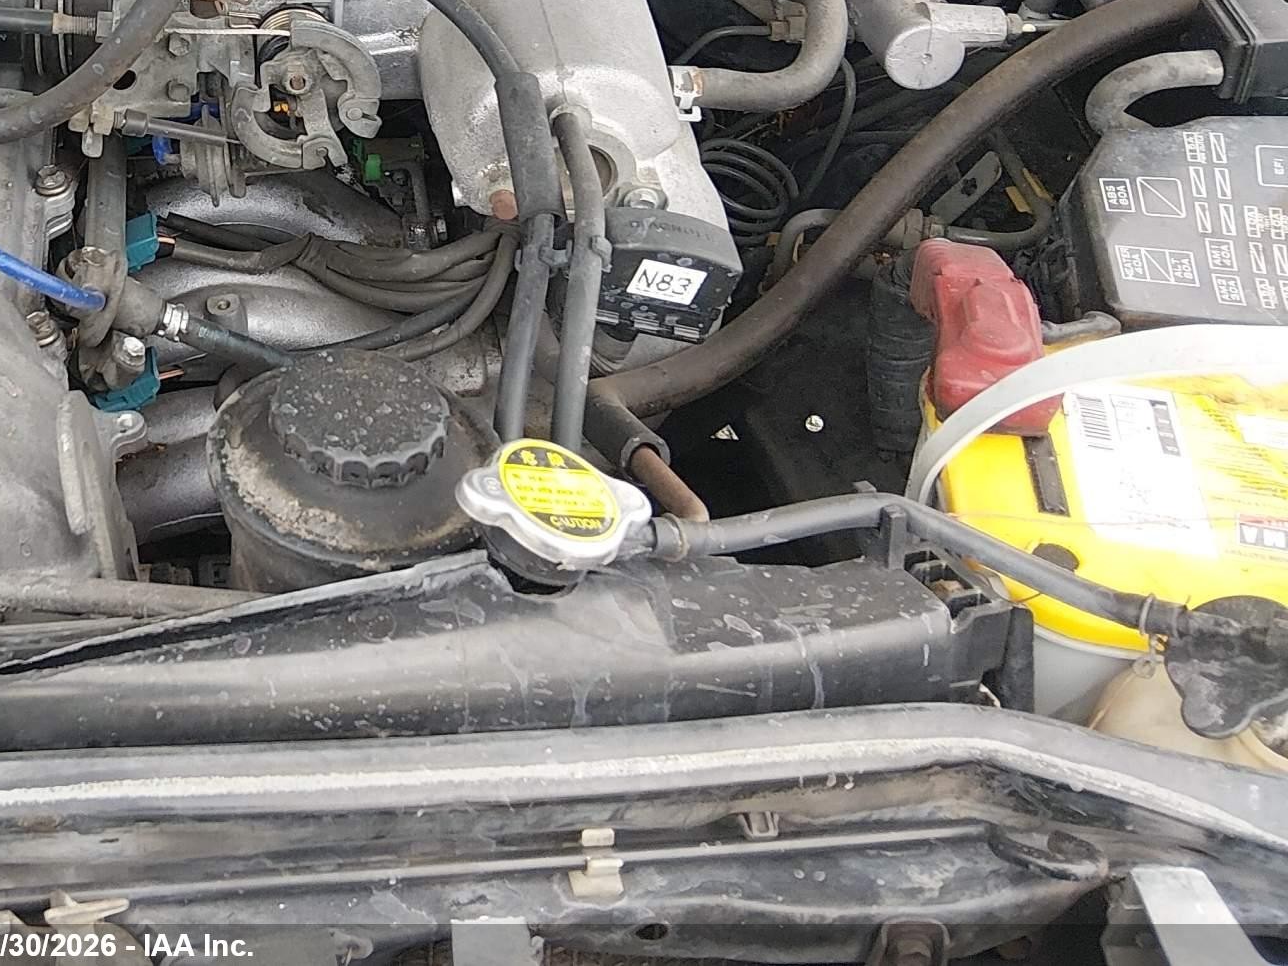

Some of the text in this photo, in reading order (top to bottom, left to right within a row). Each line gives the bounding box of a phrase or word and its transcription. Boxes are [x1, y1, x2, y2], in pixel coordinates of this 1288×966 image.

[1272, 158, 1285, 176] EFI
[1105, 185, 1118, 206] ABS
[1131, 253, 1144, 275] 40A
[1211, 244, 1224, 266] AM1
[1172, 256, 1185, 278] ALT
[637, 268, 693, 295] N83
[549, 515, 602, 530] CAUTION
